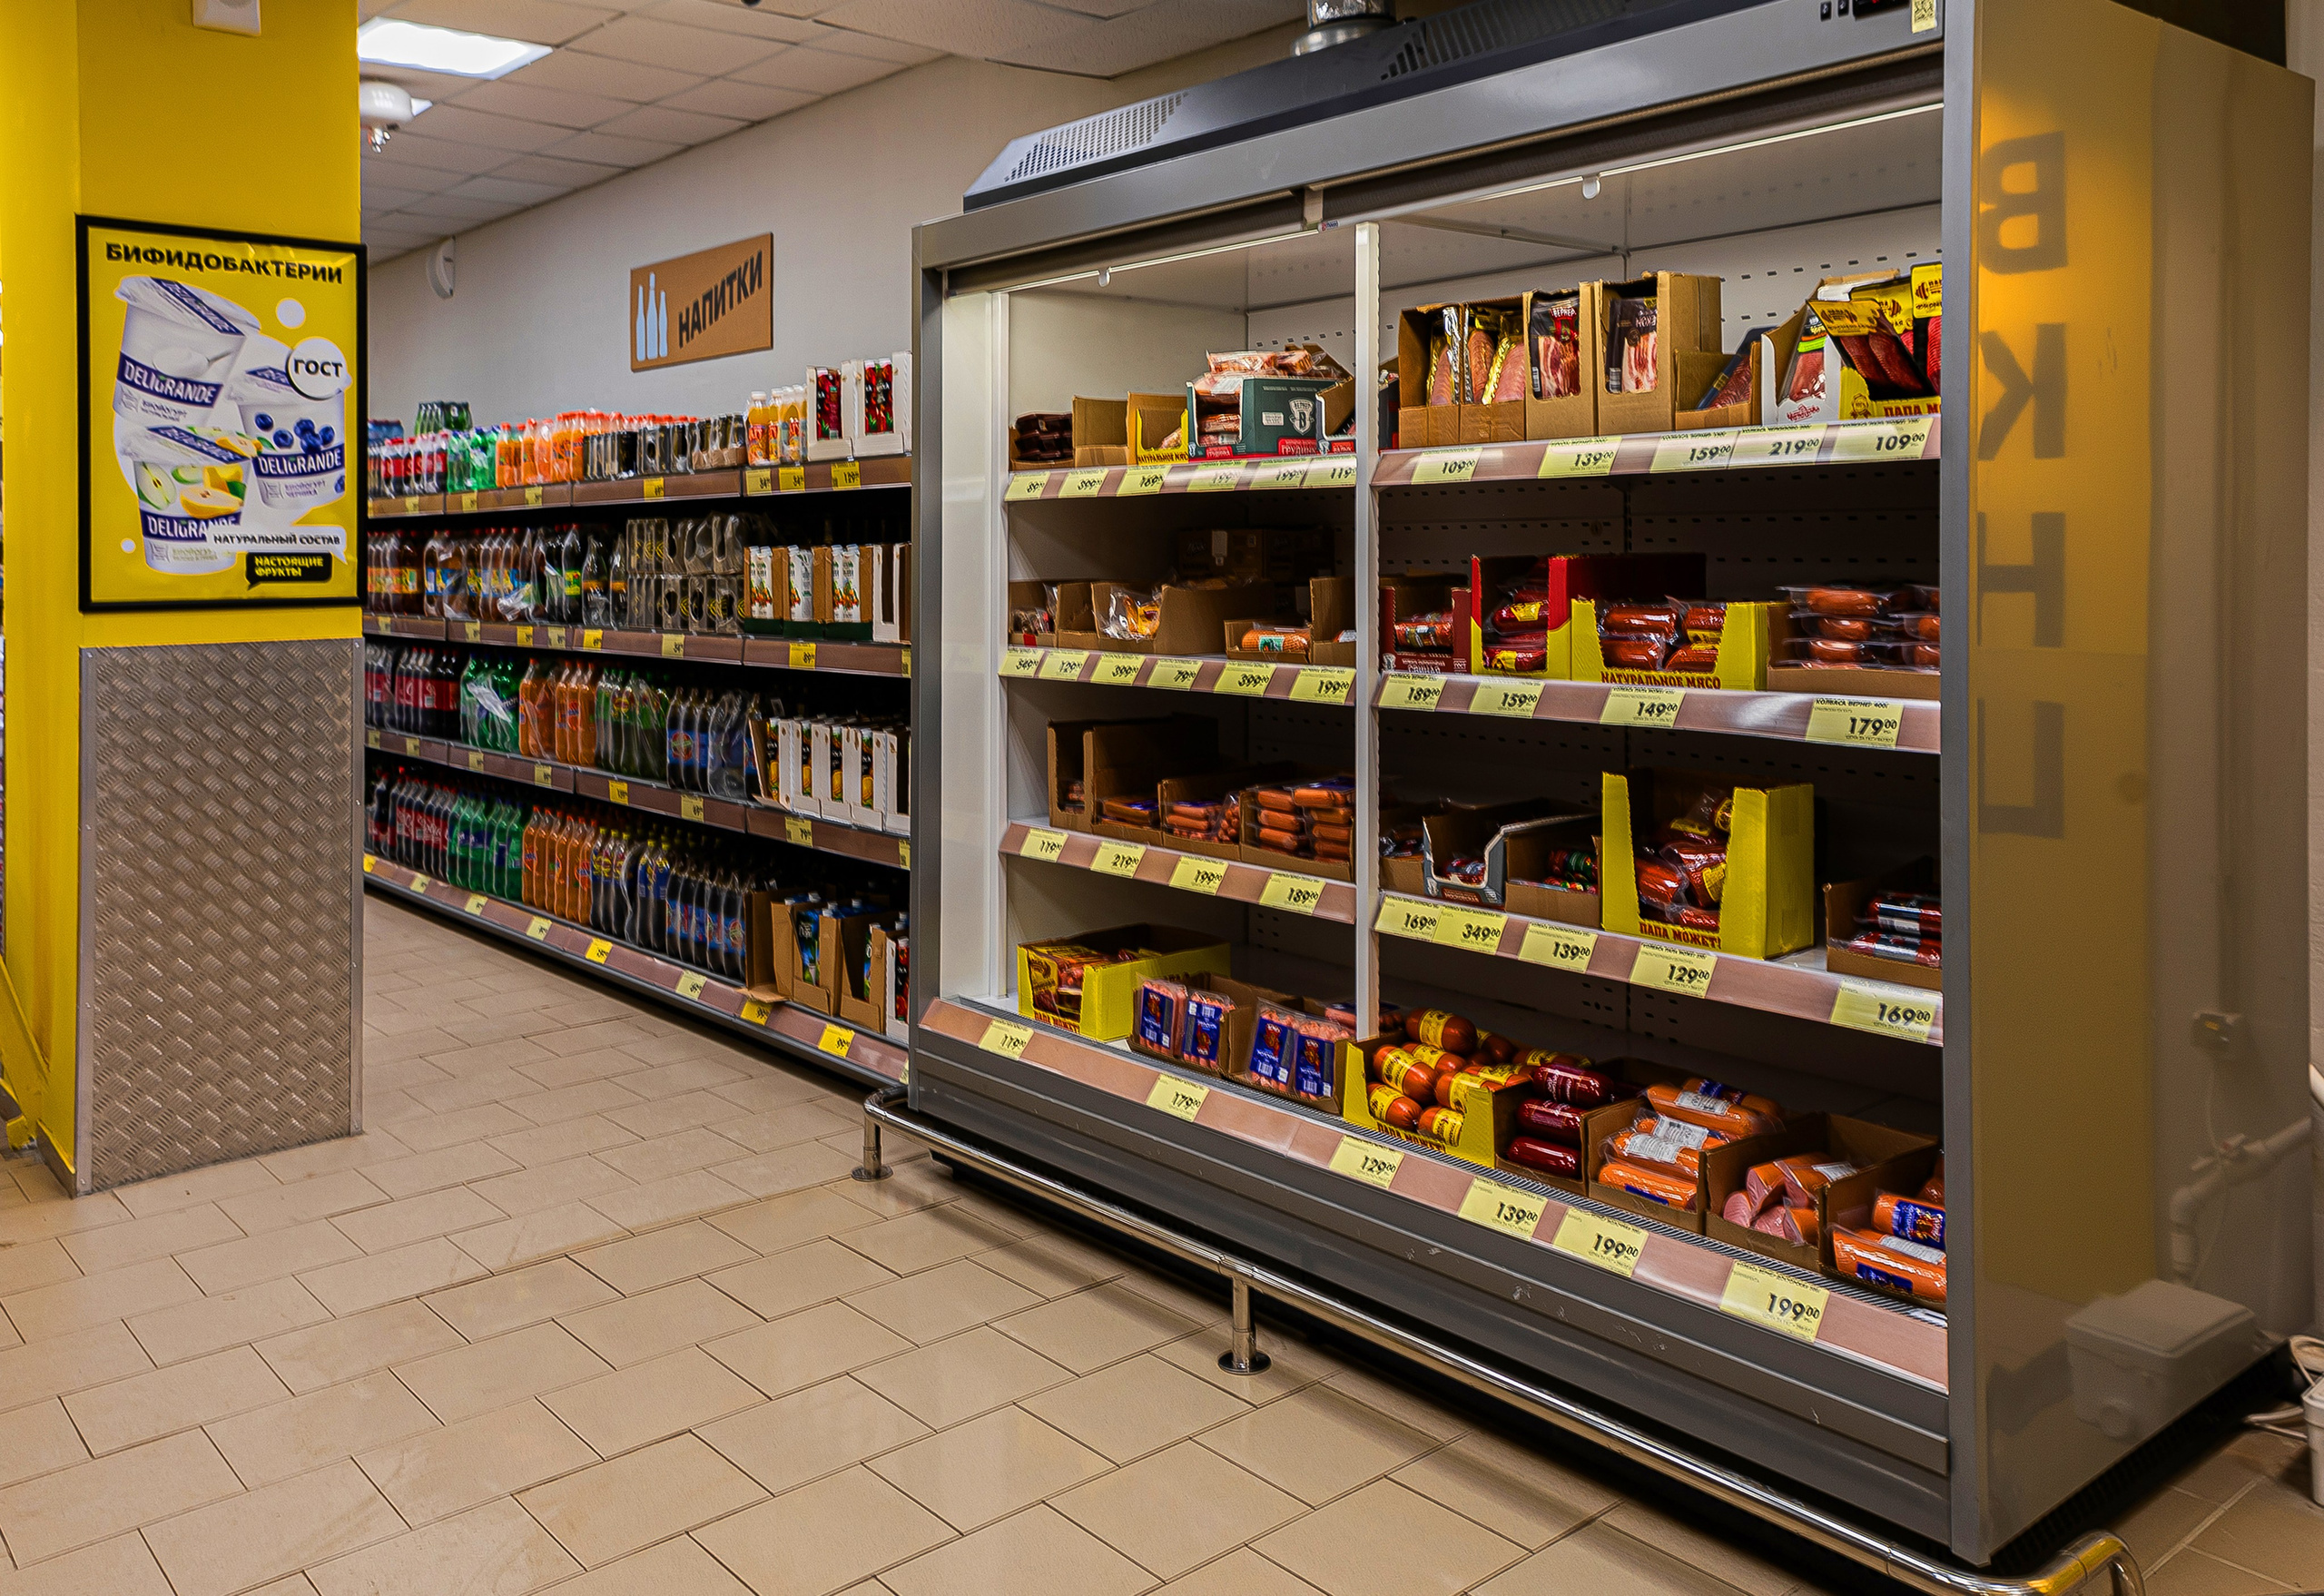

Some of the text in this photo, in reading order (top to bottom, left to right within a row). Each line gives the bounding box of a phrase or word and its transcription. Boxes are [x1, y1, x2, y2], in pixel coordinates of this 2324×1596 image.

[105, 242, 342, 284] БИФИДОБАКТЕРИИ
[678, 250, 763, 349] НАПИТКИ
[293, 359, 343, 378] ГОСТ
[124, 360, 217, 404] DELIGRANDE
[1884, 405, 1923, 419] ПАПА
[1175, 453, 1188, 462] МЯС
[1281, 444, 1316, 455] ГРУДИНК
[258, 449, 341, 475] DELIGRANDE
[213, 533, 340, 545] НАТУРАЛЬНЫЙ СОСТАВ
[254, 556, 324, 567] НАСТОЯЩИЕ
[254, 567, 302, 576] ФРУКТЫ
[1600, 672, 1721, 690] НАТУРАЛЬНОЕ МЯСО
[1640, 922, 1669, 940] ПАПА
